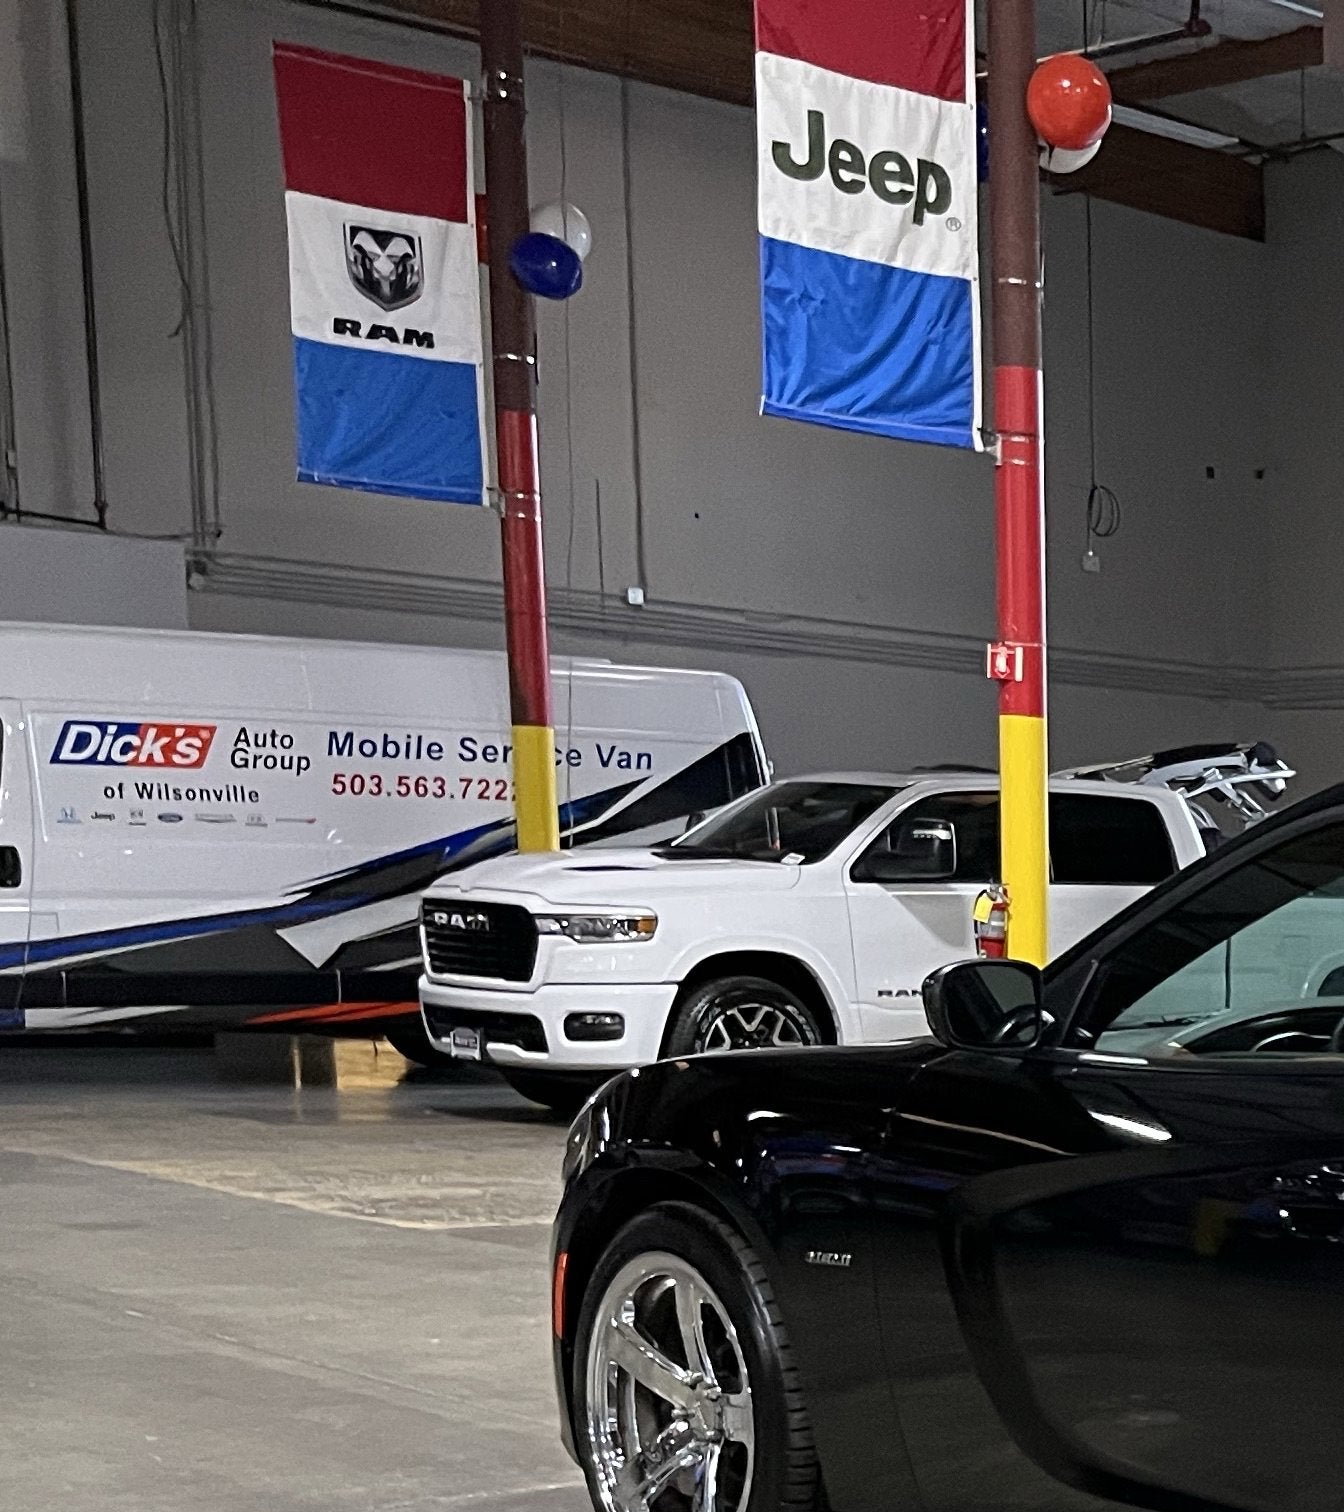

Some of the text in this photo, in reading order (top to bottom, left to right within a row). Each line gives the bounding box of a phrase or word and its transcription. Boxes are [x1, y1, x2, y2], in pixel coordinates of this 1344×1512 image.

[772, 109, 952, 226] Jeep
[333, 317, 435, 349] RAM
[59, 724, 652, 770] Dick's Auto Mobile Sere Van
[230, 748, 311, 776] Group
[104, 782, 260, 803] of Wilsonville
[332, 774, 516, 801] 503.563.722
[434, 911, 490, 931] RAM
